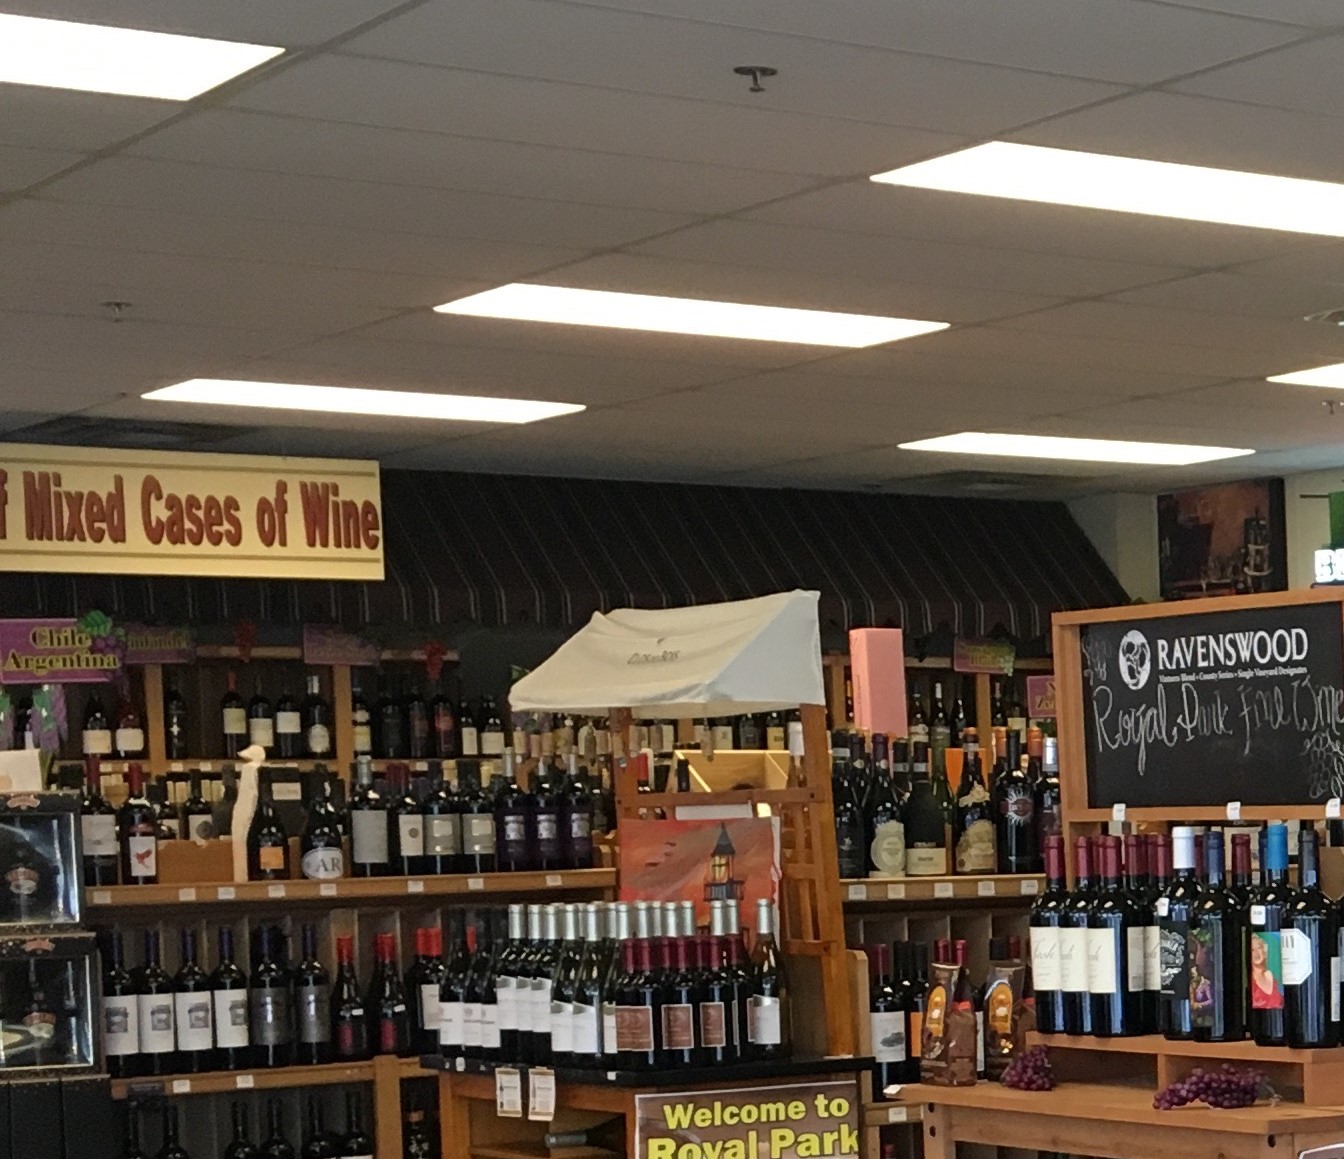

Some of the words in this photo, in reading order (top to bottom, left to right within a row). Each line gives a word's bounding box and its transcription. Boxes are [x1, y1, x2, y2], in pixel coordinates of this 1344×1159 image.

[23, 470, 126, 543] Mixed
[140, 474, 243, 547] Cases
[256, 479, 288, 547] of
[299, 481, 380, 550] Wine
[30, 627, 91, 649] Chile
[1157, 627, 1309, 671] RAVENSWOOD
[4, 650, 120, 677] Argentina
[1093, 684, 1178, 776] Royal
[663, 1101, 807, 1130] Welcome
[815, 1093, 850, 1118] to
[770, 1123, 859, 1159] Park
